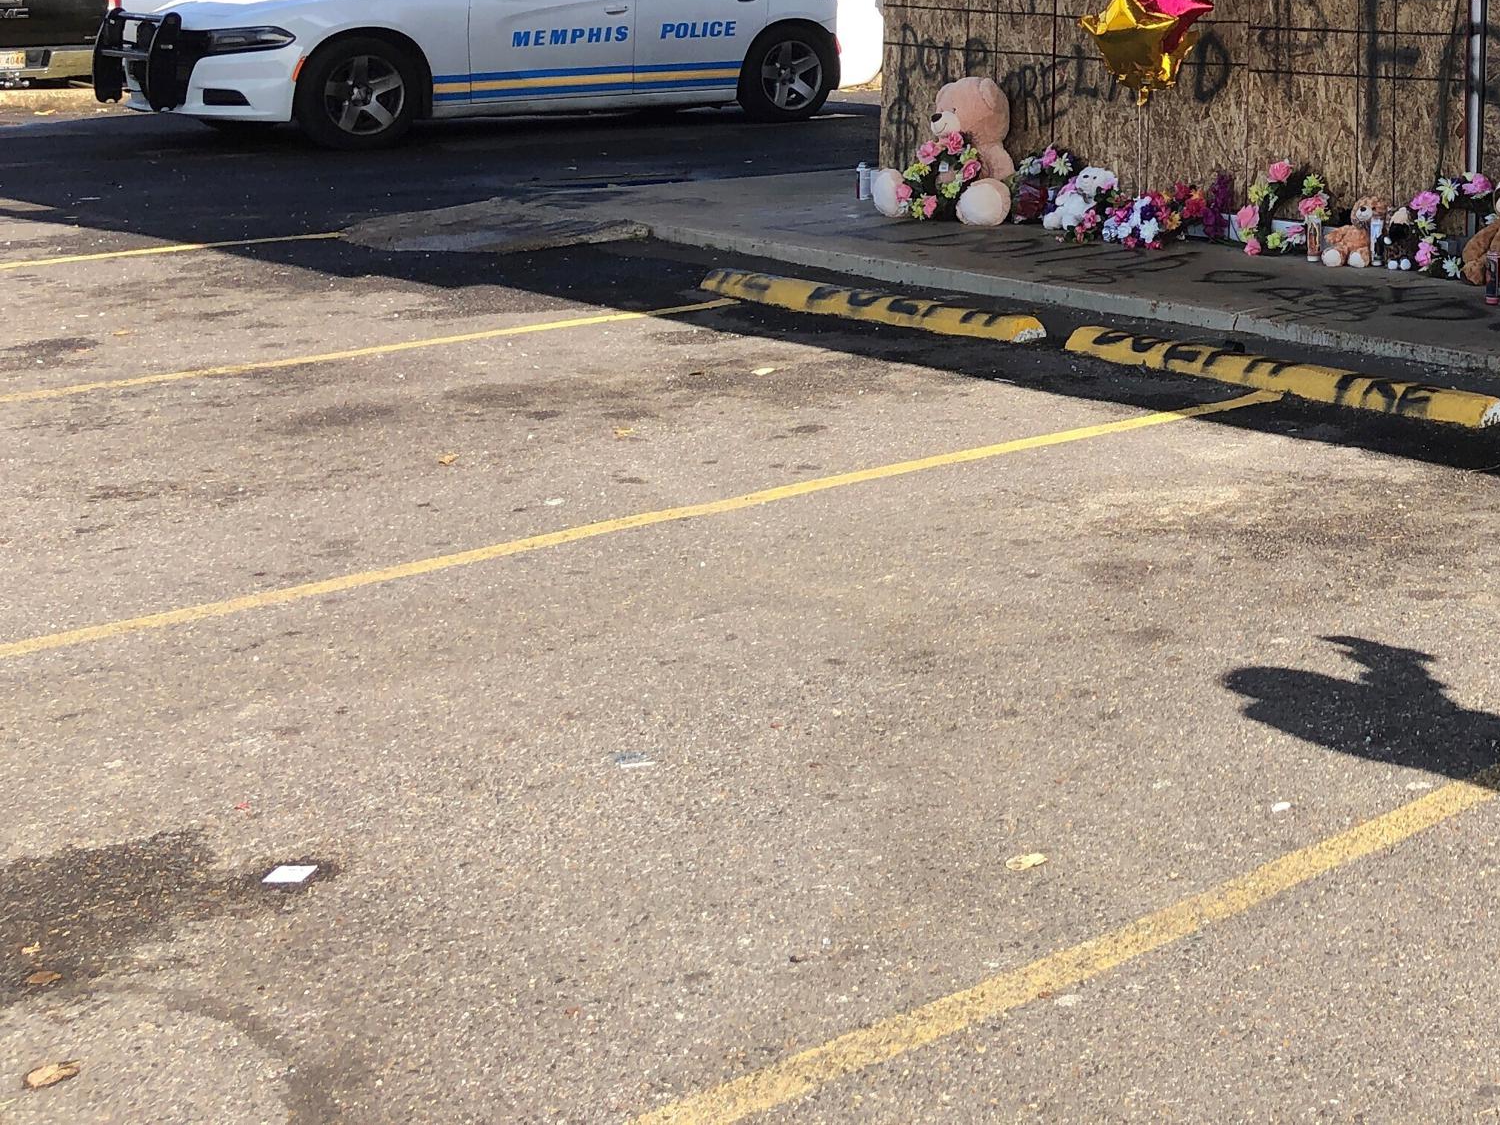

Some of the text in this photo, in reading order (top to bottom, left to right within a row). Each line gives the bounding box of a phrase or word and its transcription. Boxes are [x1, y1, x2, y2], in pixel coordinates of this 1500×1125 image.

[0, 8, 29, 19] MC
[512, 20, 738, 48] MEMPHIS POLICE
